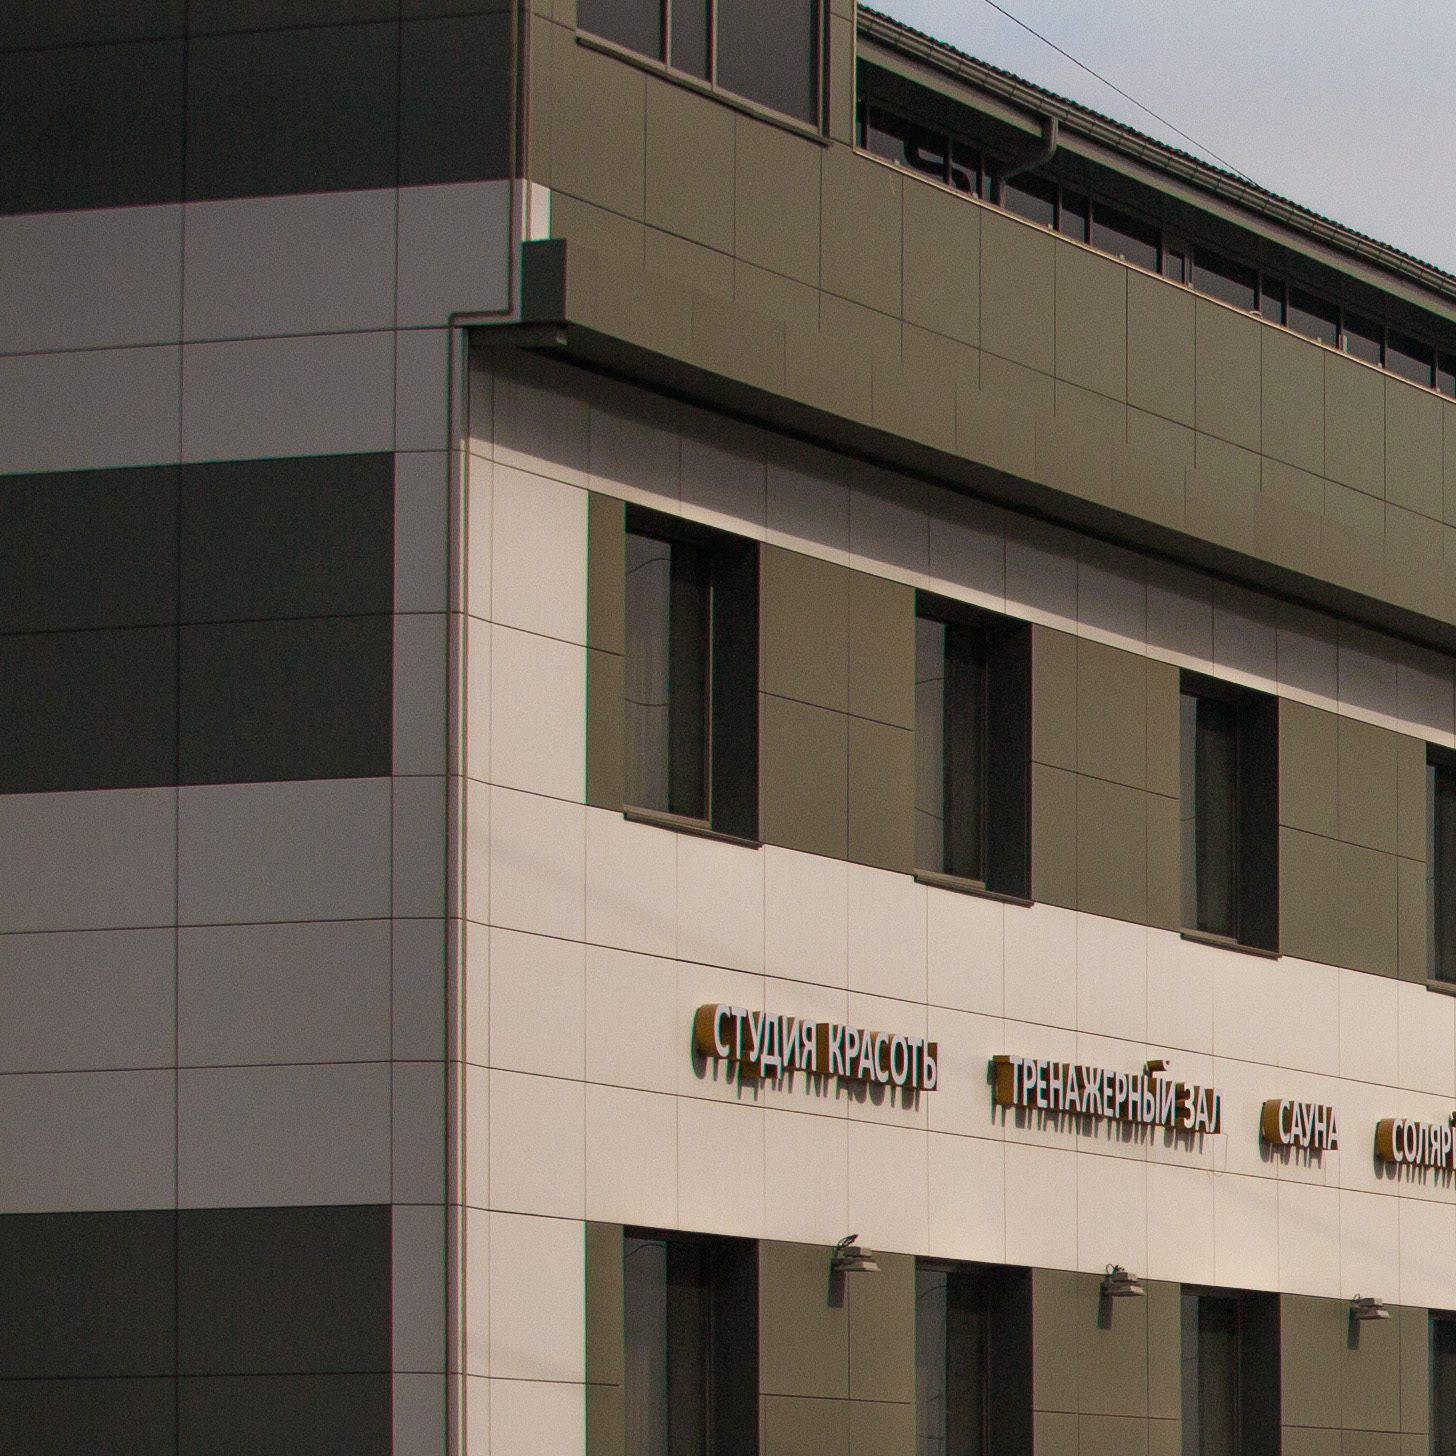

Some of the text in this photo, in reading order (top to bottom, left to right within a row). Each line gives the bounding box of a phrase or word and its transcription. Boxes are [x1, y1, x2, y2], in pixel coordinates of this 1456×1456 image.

[713, 1003, 942, 1092] СТУДИЯ КРАСОТЫ
[1010, 1055, 1224, 1134] ТРЕНАЖЕРНЫЙ ЗАЛ
[1279, 1099, 1339, 1150] САУНА
